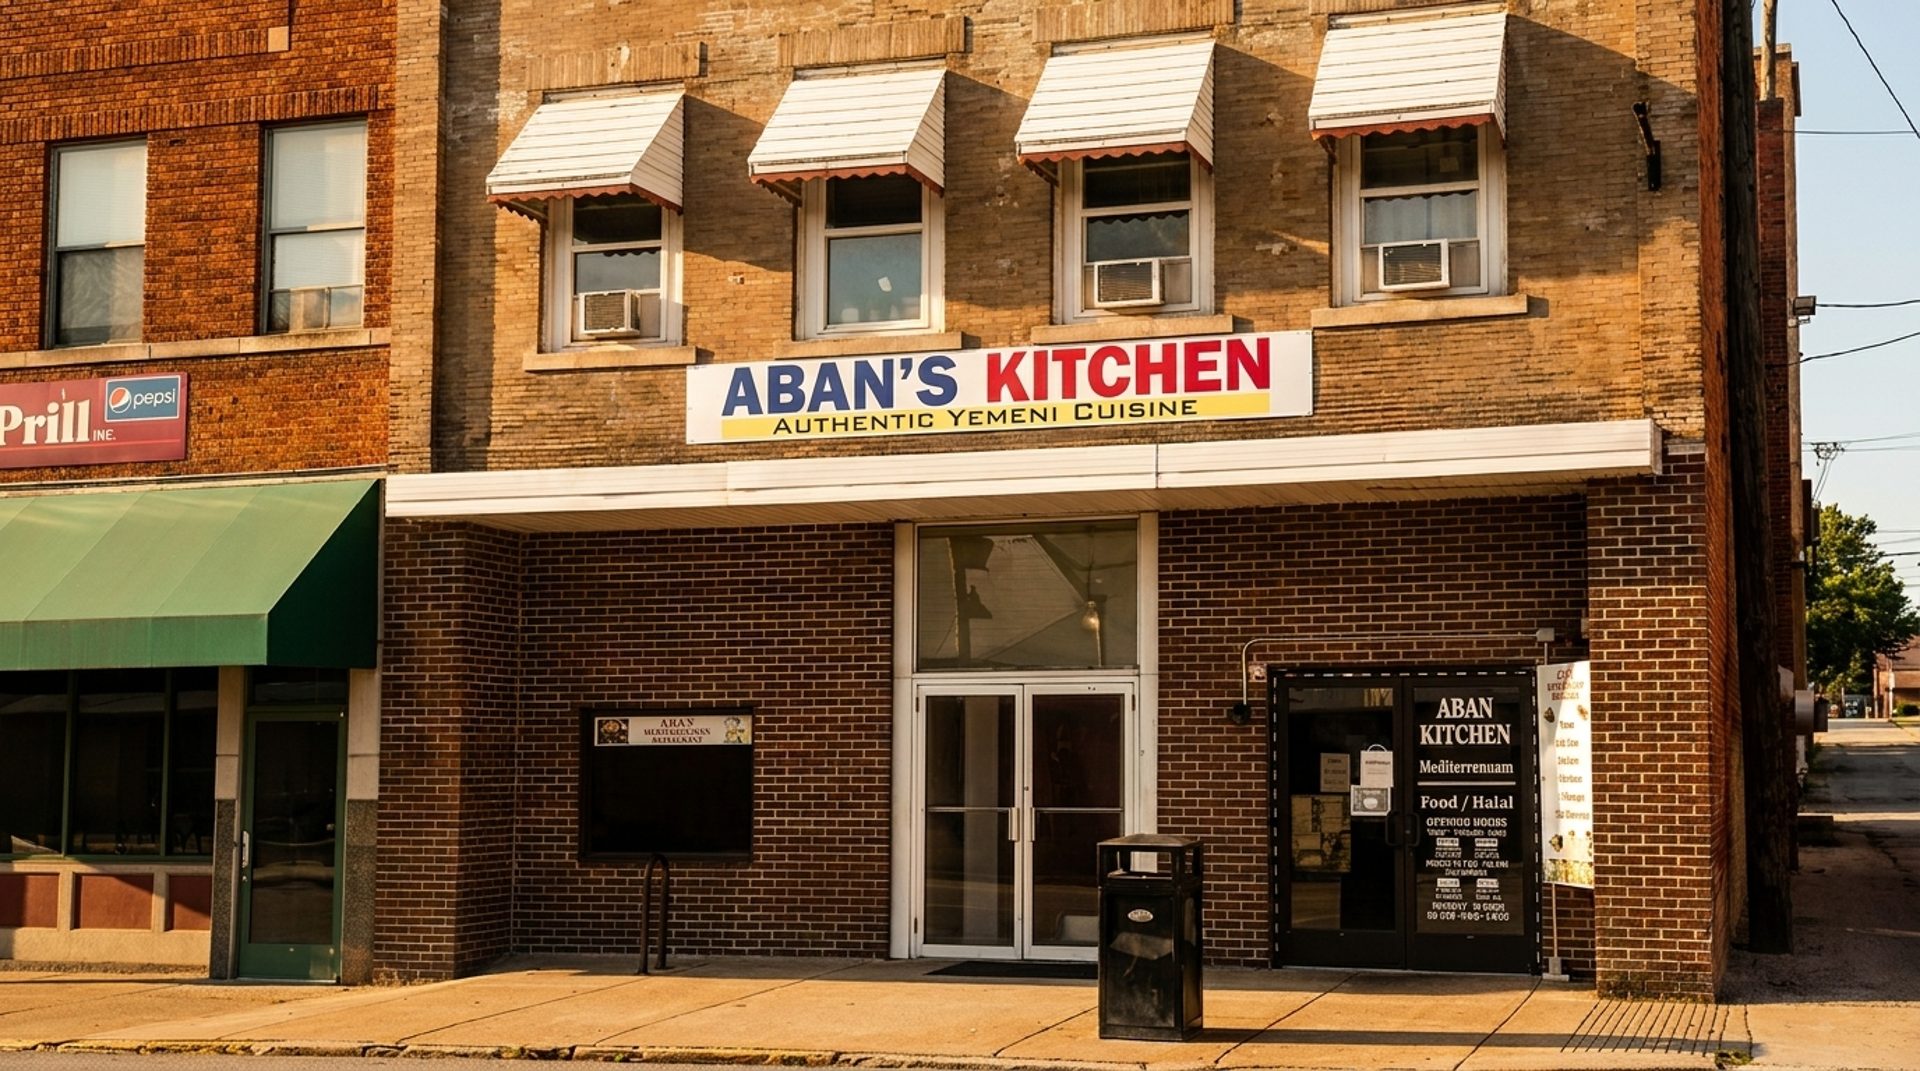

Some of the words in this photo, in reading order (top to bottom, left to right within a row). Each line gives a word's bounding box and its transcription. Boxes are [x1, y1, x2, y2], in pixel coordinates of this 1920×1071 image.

[722, 355, 958, 416] ABAN'S
[987, 337, 1270, 403] KITCHEN
[133, 388, 176, 410] pepsi
[0, 399, 90, 446] Prill
[773, 412, 934, 435] AUTHENTIC
[946, 406, 1057, 427] YEMENI
[1074, 400, 1198, 421] CUISINE
[1436, 697, 1494, 719] ABAN
[1419, 723, 1511, 745] KITCHEN
[1421, 795, 1458, 810] Food
[1461, 795, 1469, 812] /
[1472, 795, 1514, 809] Halal
